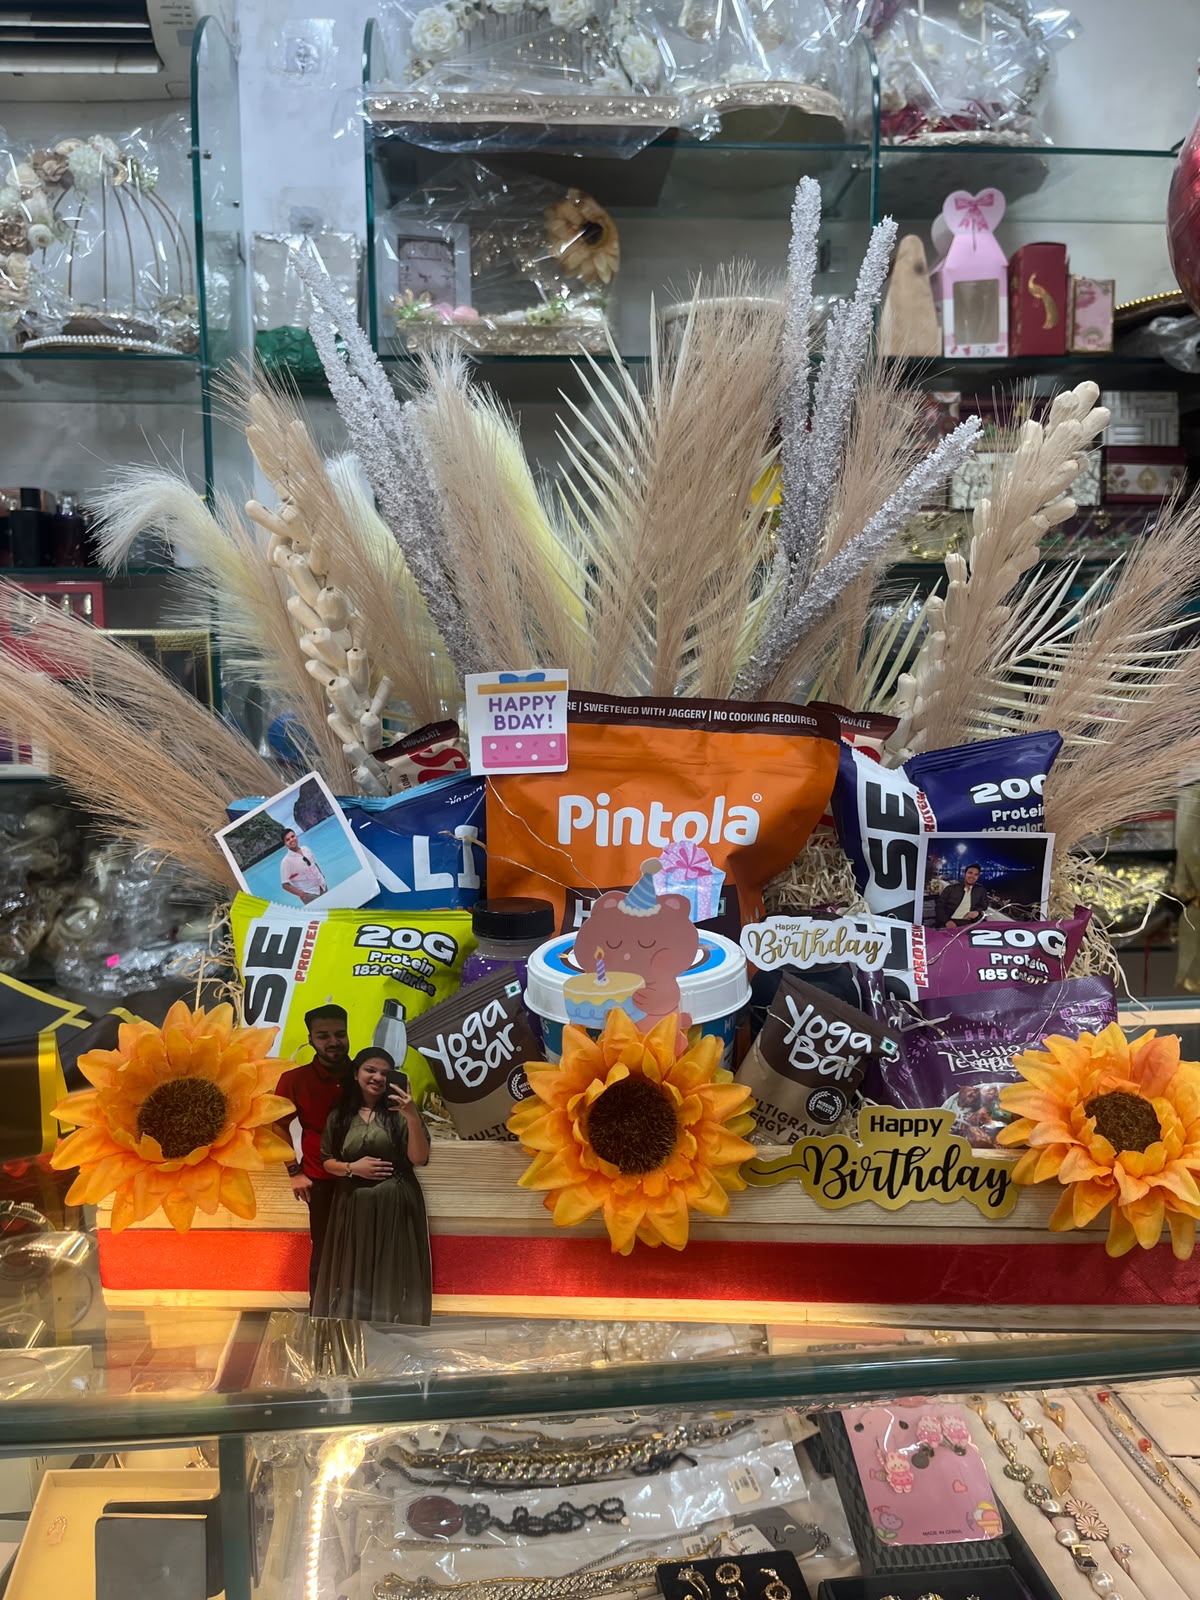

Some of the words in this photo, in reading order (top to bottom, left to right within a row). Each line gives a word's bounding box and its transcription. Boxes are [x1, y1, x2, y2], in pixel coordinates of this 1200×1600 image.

[488, 695, 556, 713] HAPPY
[584, 702, 639, 715] SWEETENED
[641, 707, 665, 716] WITH
[667, 708, 707, 720] JAGGERY
[714, 710, 728, 721] NO
[729, 712, 770, 723] COOKING
[772, 713, 818, 726] REQUIRED
[494, 713, 553, 731] BDAY!
[557, 792, 761, 848] Pintola
[775, 923, 801, 932] Happy
[355, 925, 458, 966] 20G
[747, 926, 884, 964] Birthday
[369, 951, 435, 977] Protein
[977, 968, 1009, 981] 185
[989, 952, 1050, 974] Protein
[354, 965, 380, 976] 182
[381, 966, 437, 997] Calories
[783, 994, 872, 1055] Yoga
[964, 1028, 1013, 1042] BEAN
[417, 999, 508, 1081] Yoga
[959, 1045, 1021, 1058] Hello
[454, 1022, 514, 1088] Bar
[788, 1034, 862, 1081] Bar
[869, 1115, 944, 1137] Happy
[802, 1143, 1013, 1208] Birthday
